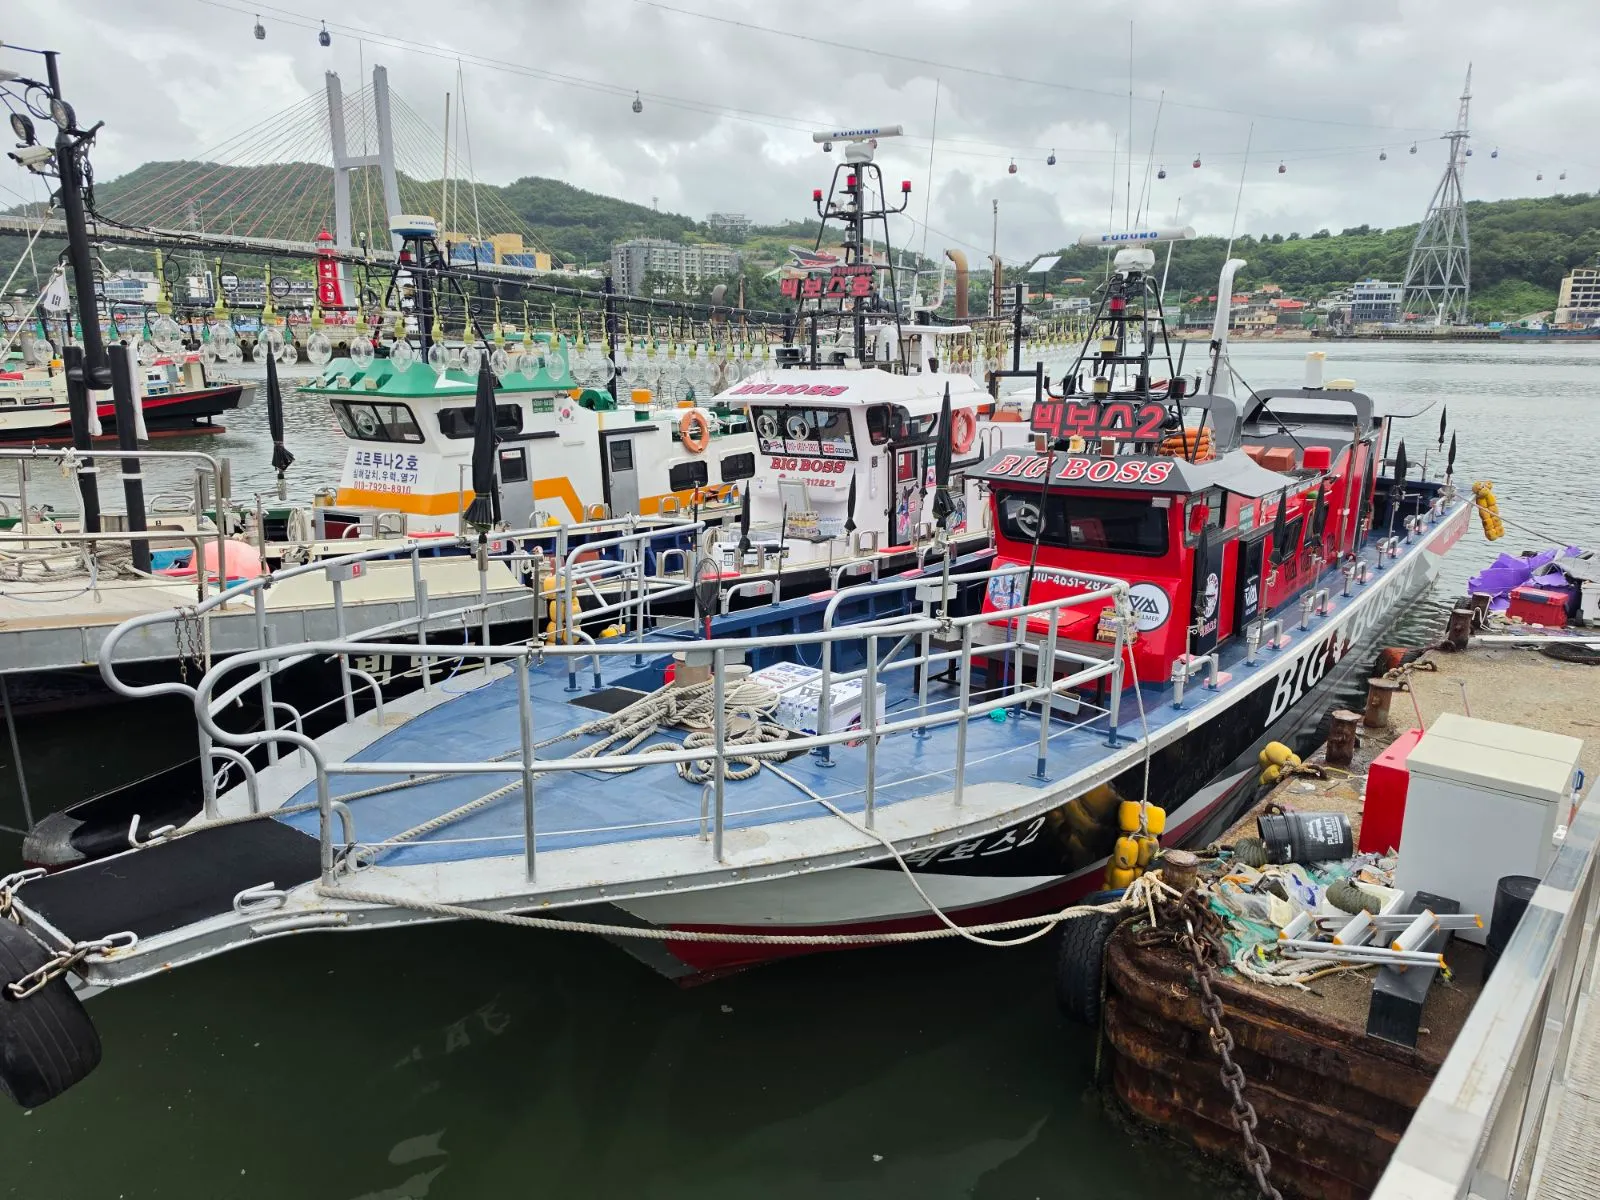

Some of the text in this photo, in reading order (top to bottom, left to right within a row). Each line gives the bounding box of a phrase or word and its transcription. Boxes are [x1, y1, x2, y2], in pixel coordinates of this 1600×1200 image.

[833, 128, 879, 138] FURUNO
[1101, 231, 1158, 242] FURUNO
[831, 266, 873, 276] FISHING
[781, 275, 872, 300] 빅보스호
[767, 384, 849, 397] BOSS
[1033, 402, 1164, 439] 빅보스2
[354, 451, 419, 472] 포르투나2호
[770, 456, 847, 474] BIG BOSS
[987, 454, 1174, 485] BIG BOSS
[353, 481, 412, 495] 010-7929-8910
[1264, 636, 1332, 728] BIG
